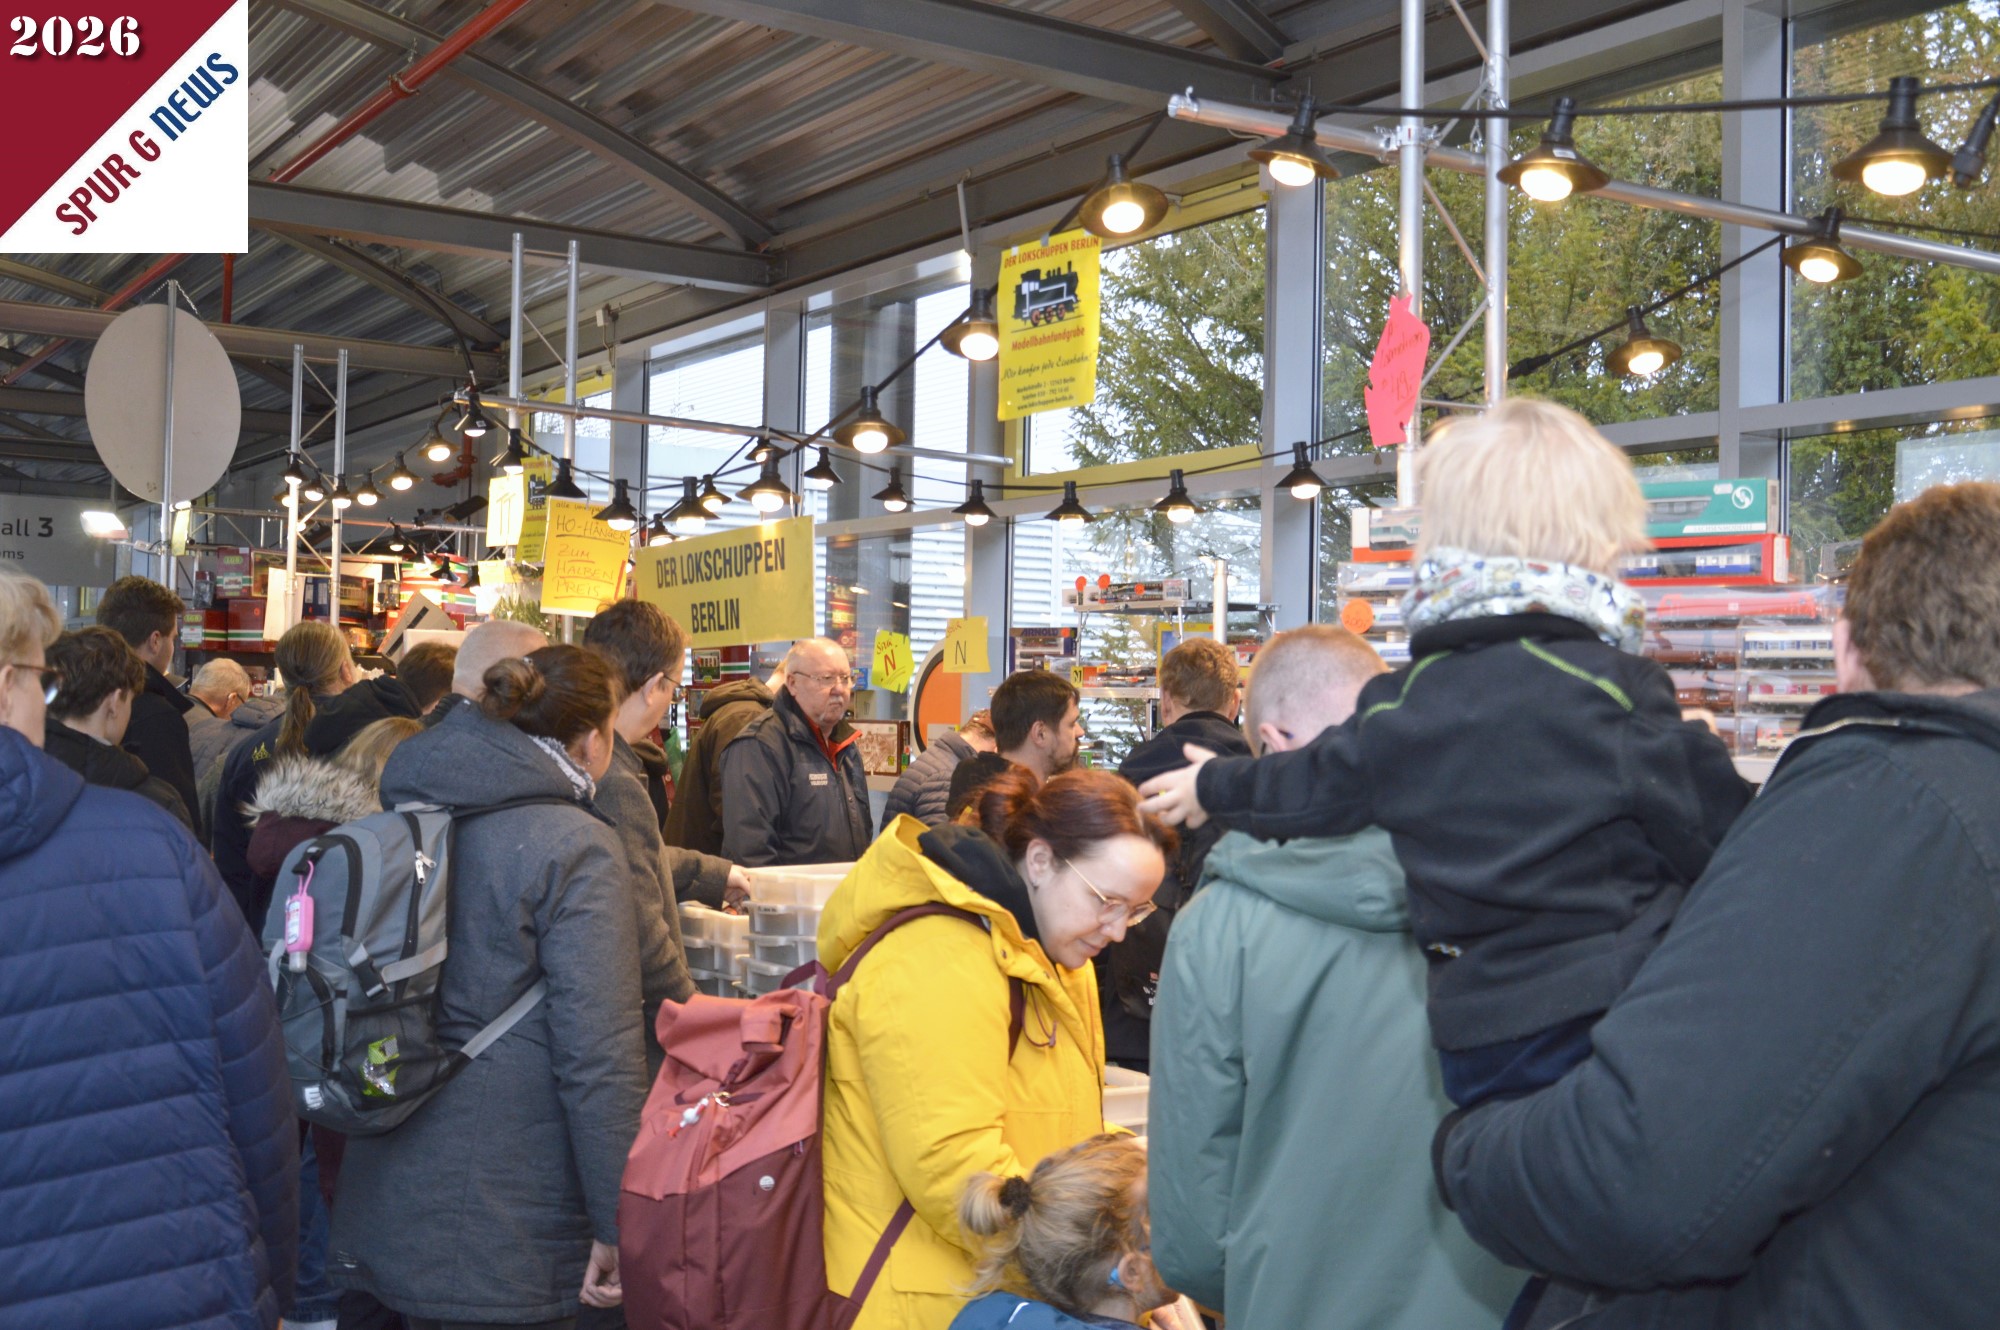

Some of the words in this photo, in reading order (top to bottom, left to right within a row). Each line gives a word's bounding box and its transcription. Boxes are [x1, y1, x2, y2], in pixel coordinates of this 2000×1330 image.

[1004, 255, 1017, 269] DER
[1018, 241, 1069, 264] LOKSCHUPPEN
[1070, 237, 1100, 252] BERLIN
[555, 500, 569, 509] alle
[37, 516, 54, 538] 3
[0, 549, 25, 560] ms
[656, 558, 679, 590] DER
[680, 536, 786, 586] LOKSCHUPPEN
[556, 559, 614, 580] HALBEN
[690, 597, 741, 634] BERLIN
[1021, 627, 1059, 637] ARNOLD
[883, 648, 897, 677] N
[954, 639, 968, 666] N
